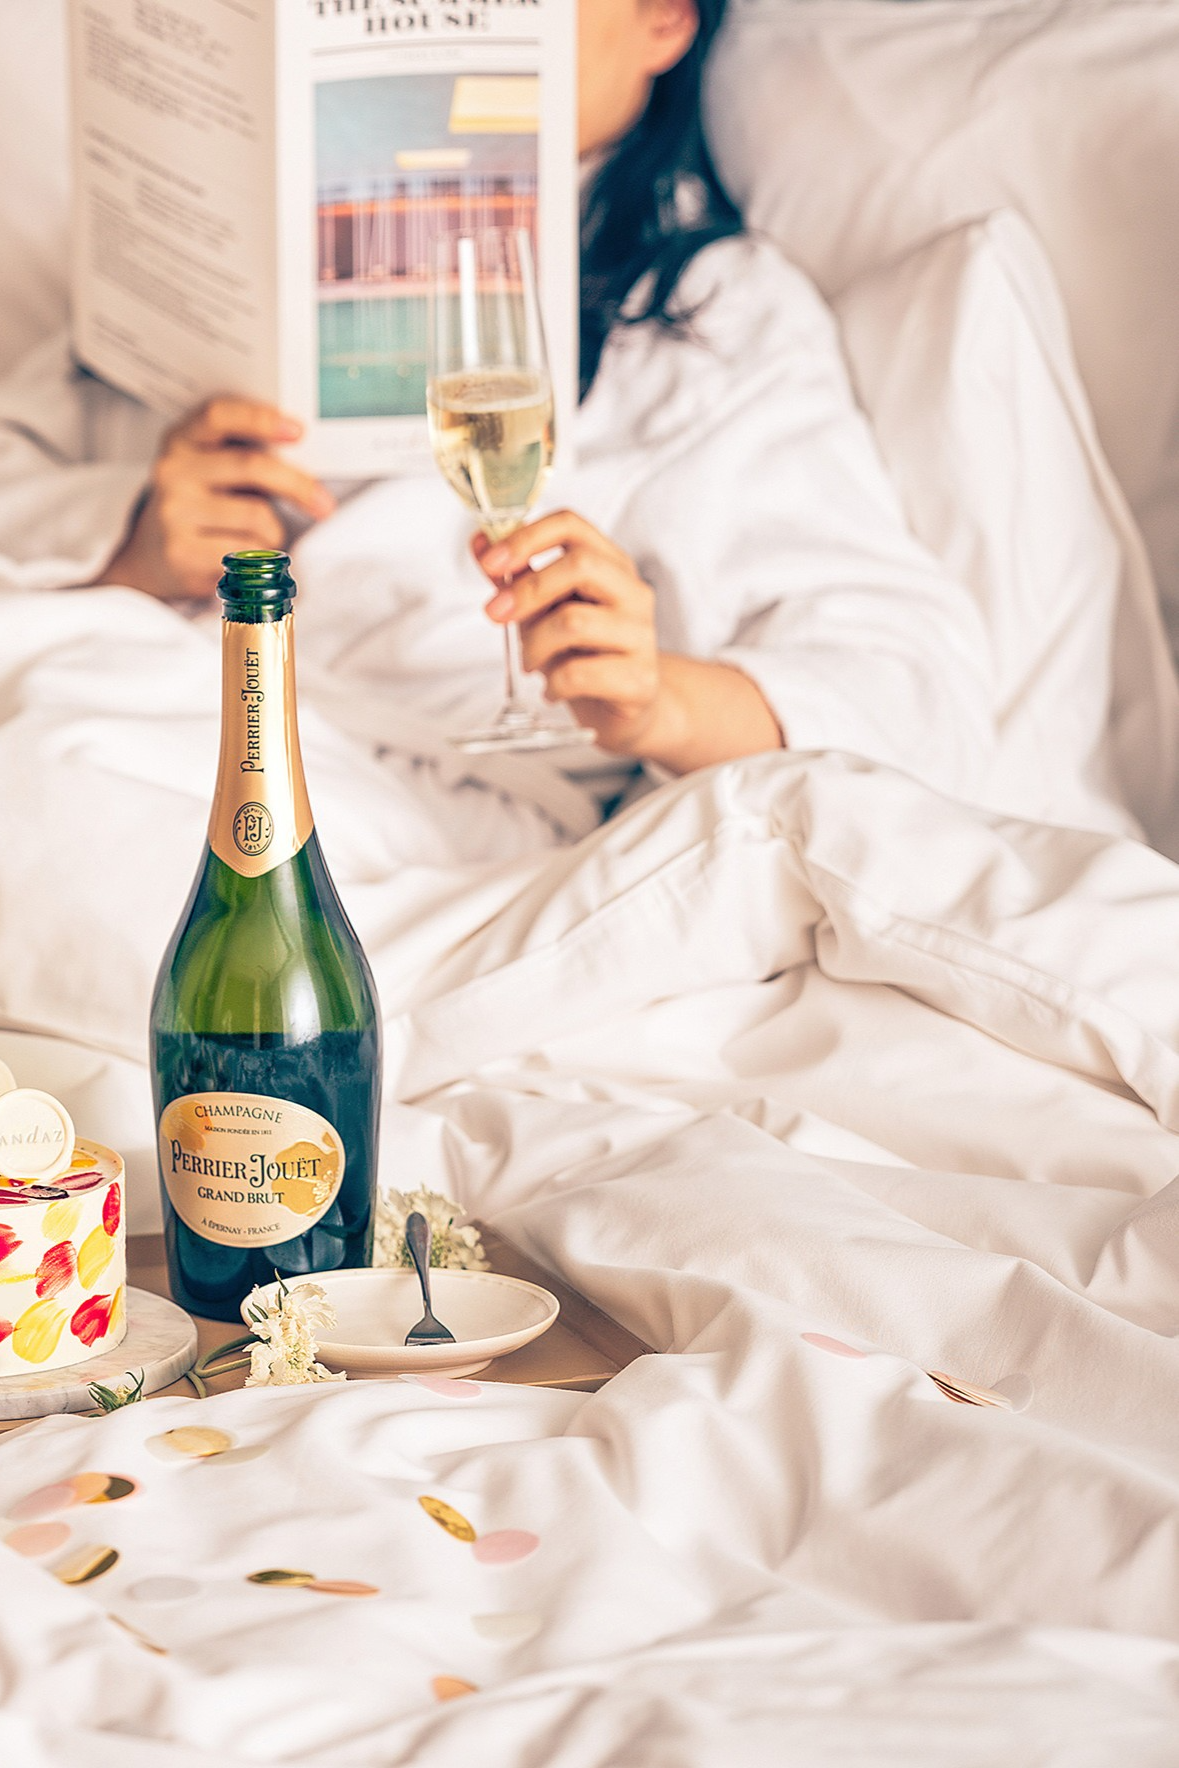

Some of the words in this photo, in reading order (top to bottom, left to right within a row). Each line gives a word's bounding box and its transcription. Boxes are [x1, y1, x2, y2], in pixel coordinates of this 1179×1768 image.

[363, 11, 489, 33] HOUSE
[240, 648, 265, 774] PERRIER-JOUËT
[194, 1105, 283, 1124] CHAMPAGNE
[171, 1139, 321, 1188] PERRIER-JOUËT
[197, 1186, 245, 1203] GRAND
[247, 1191, 285, 1204] BRUT
[247, 1222, 281, 1235] FRANCE
